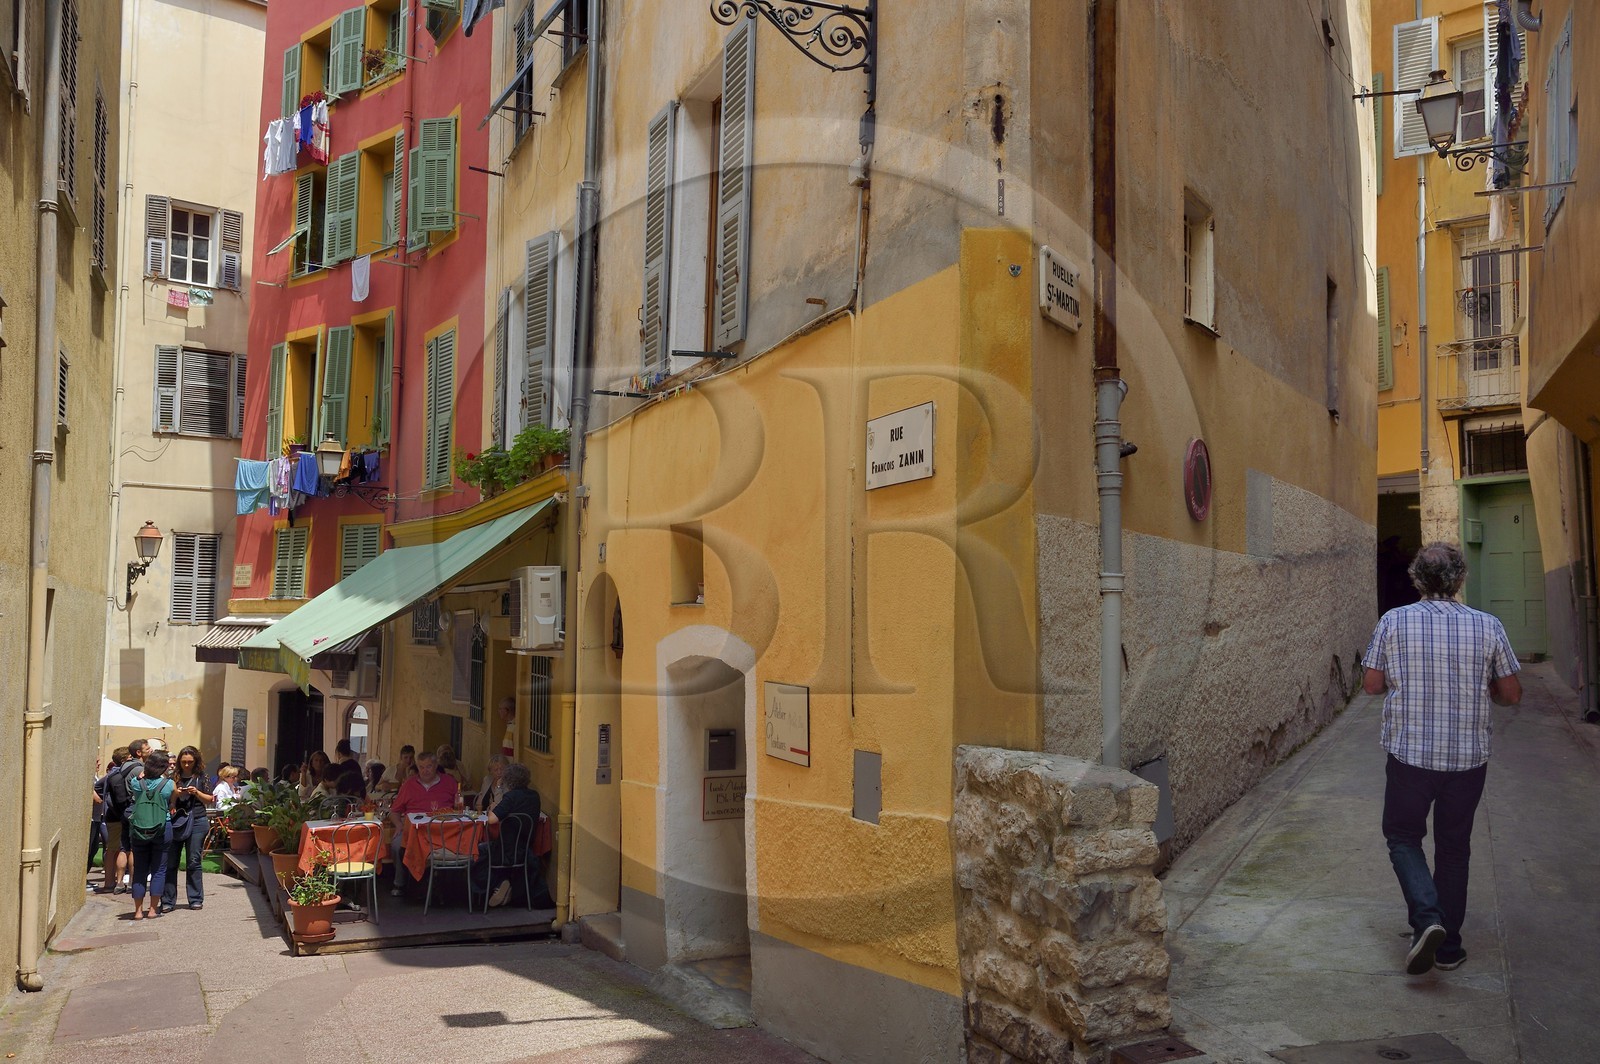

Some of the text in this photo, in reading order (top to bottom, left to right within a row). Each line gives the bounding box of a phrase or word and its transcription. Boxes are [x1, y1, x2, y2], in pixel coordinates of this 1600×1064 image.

[1052, 261, 1074, 288] RUELLE
[890, 426, 904, 442] RUE
[898, 449, 924, 468] ZANIN
[1513, 514, 1520, 525] 8
